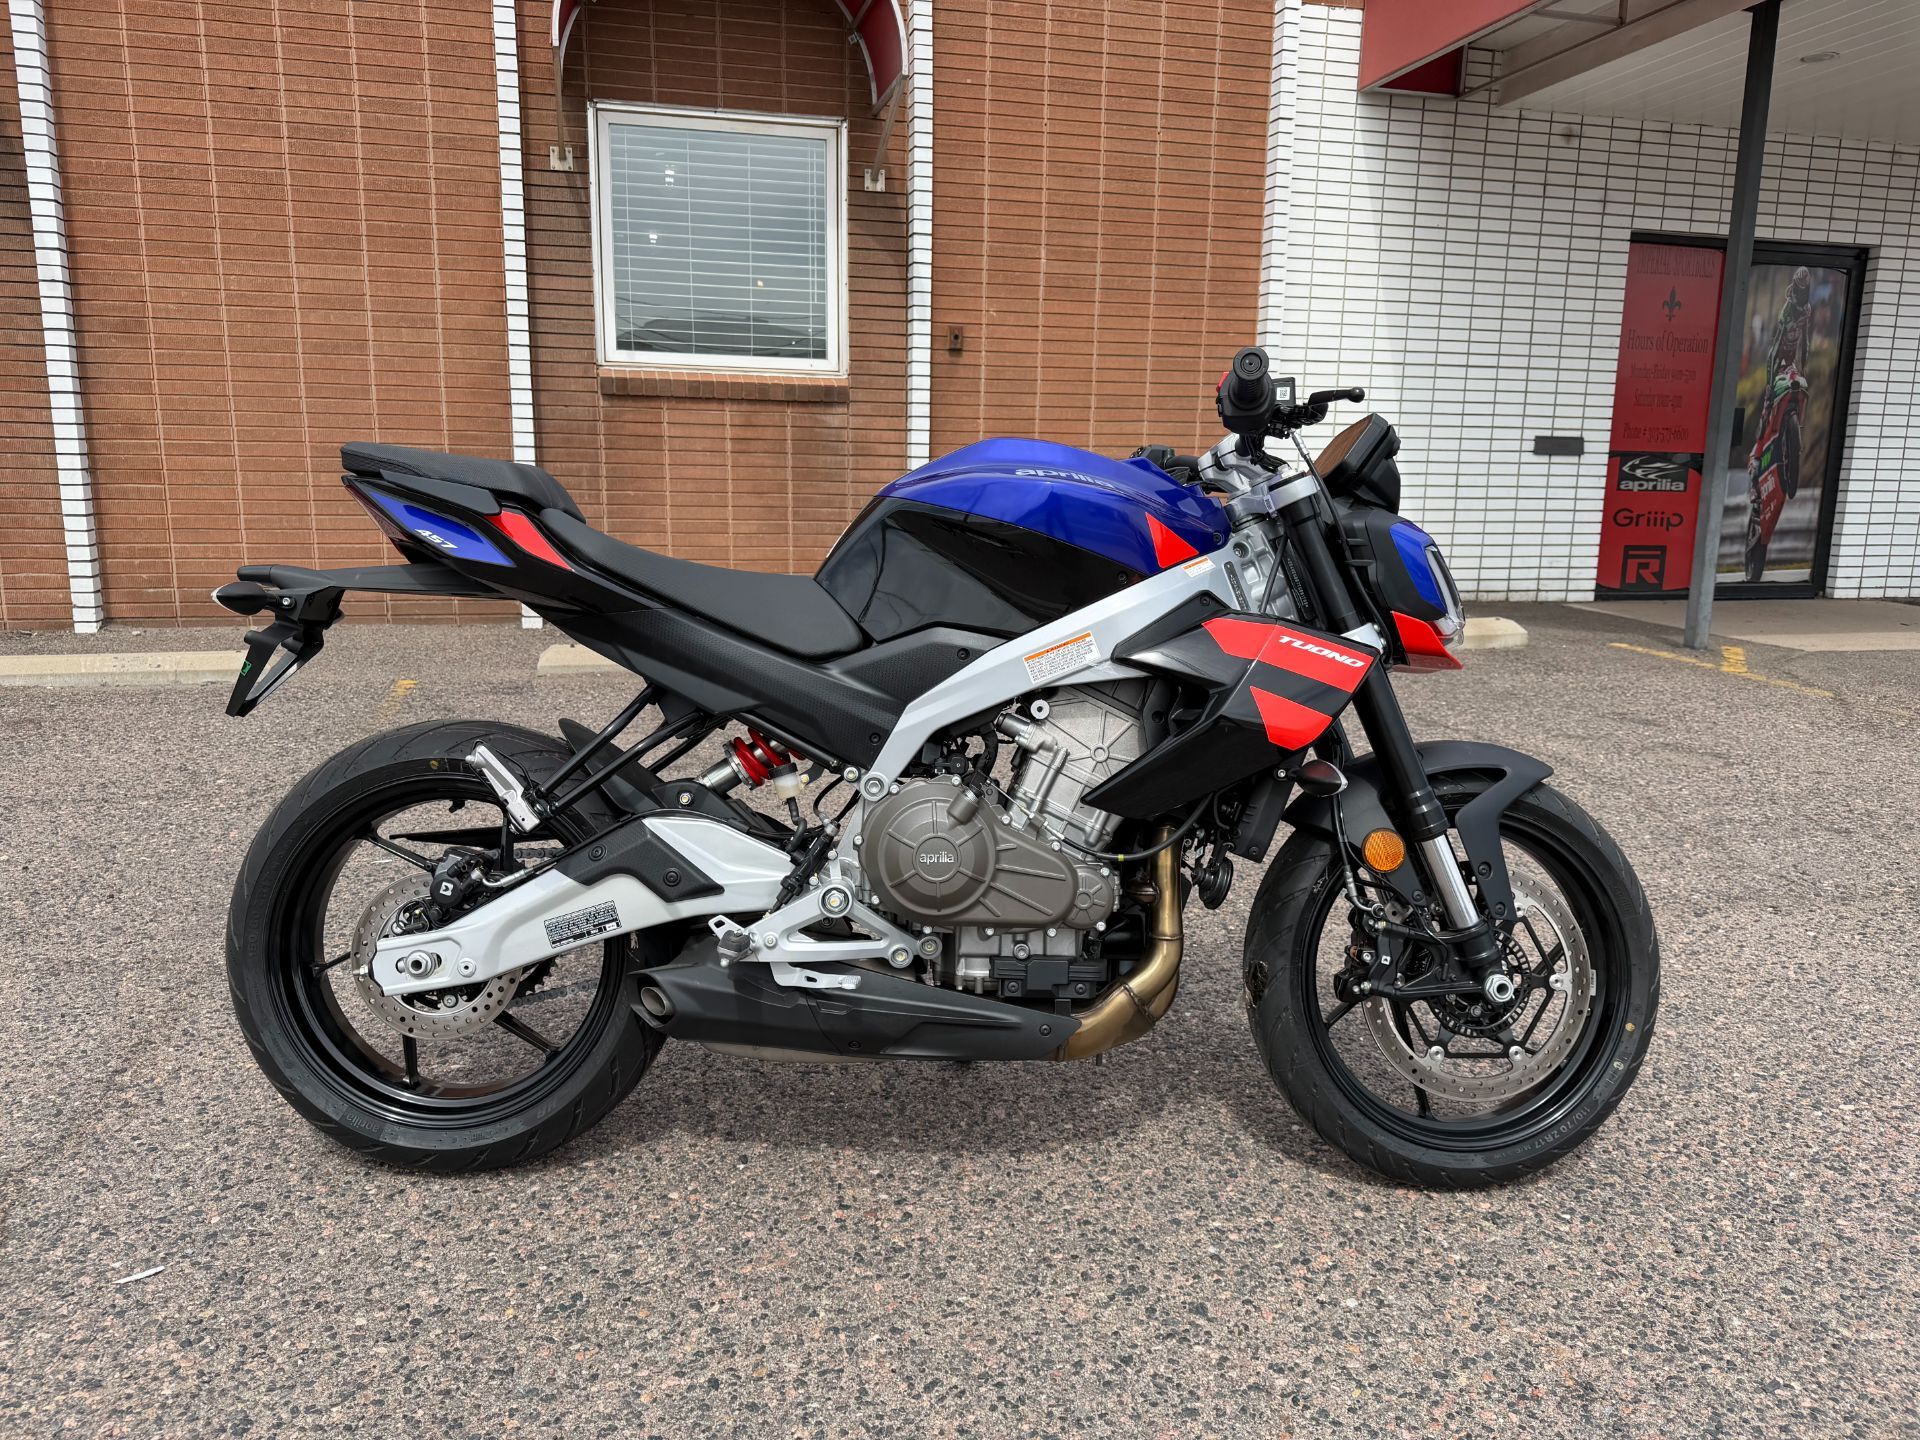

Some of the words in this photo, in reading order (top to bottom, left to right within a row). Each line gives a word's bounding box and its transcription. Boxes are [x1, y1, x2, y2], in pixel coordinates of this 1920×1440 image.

[1627, 328, 1655, 350] Hours
[1655, 330, 1667, 351] of
[1666, 331, 1709, 358] Operation
[1015, 468, 1116, 489] aprilia
[1620, 478, 1685, 492] aprilia
[1613, 507, 1684, 532] Griiip
[414, 528, 459, 549] 457
[1278, 635, 1366, 667] TUONO
[920, 851, 955, 865] aprilia
[346, 1113, 380, 1133] aprilia
[1560, 1106, 1591, 1134] 110/70
[1535, 1130, 1560, 1149] ZR17
